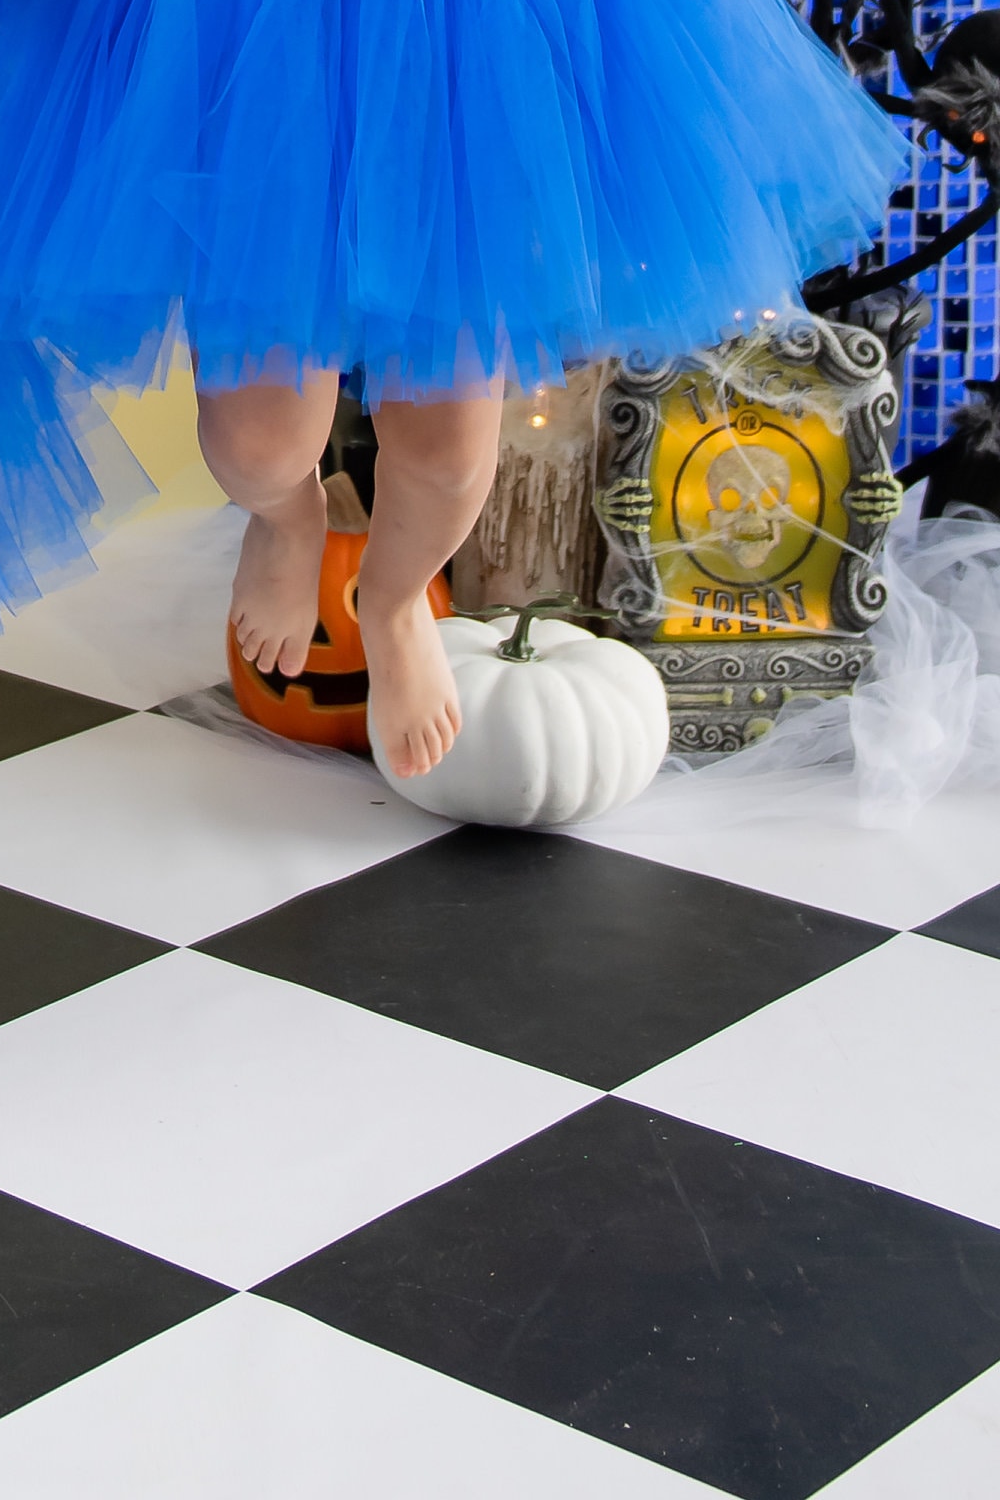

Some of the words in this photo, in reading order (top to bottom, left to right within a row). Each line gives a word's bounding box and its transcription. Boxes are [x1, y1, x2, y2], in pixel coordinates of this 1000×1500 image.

[681, 366, 813, 424] TRICK
[739, 415, 758, 431] OR
[692, 581, 806, 633] TREAT
